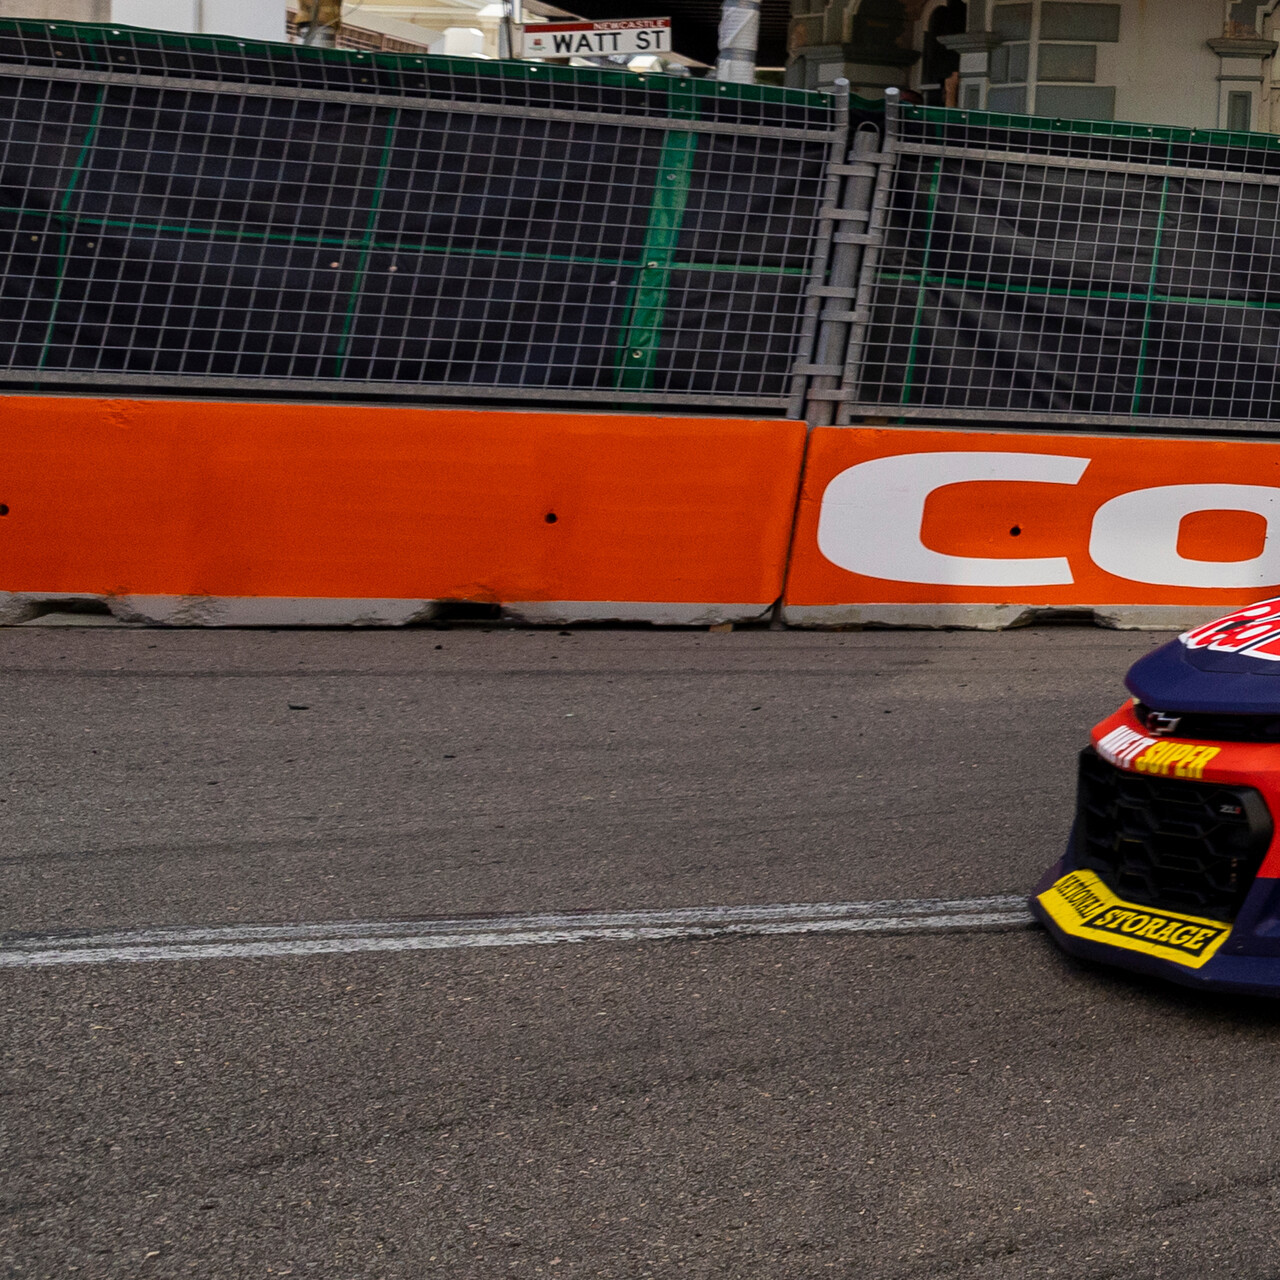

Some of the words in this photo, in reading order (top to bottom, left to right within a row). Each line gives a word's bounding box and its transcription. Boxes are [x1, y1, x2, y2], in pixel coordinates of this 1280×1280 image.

[552, 31, 622, 53] WATT
[636, 30, 666, 50] ST
[593, 20, 665, 30] NEWCASTLE
[1135, 740, 1222, 779] SUPER
[1054, 874, 1105, 920] NATIONAL
[1092, 907, 1218, 951] STORAGE
